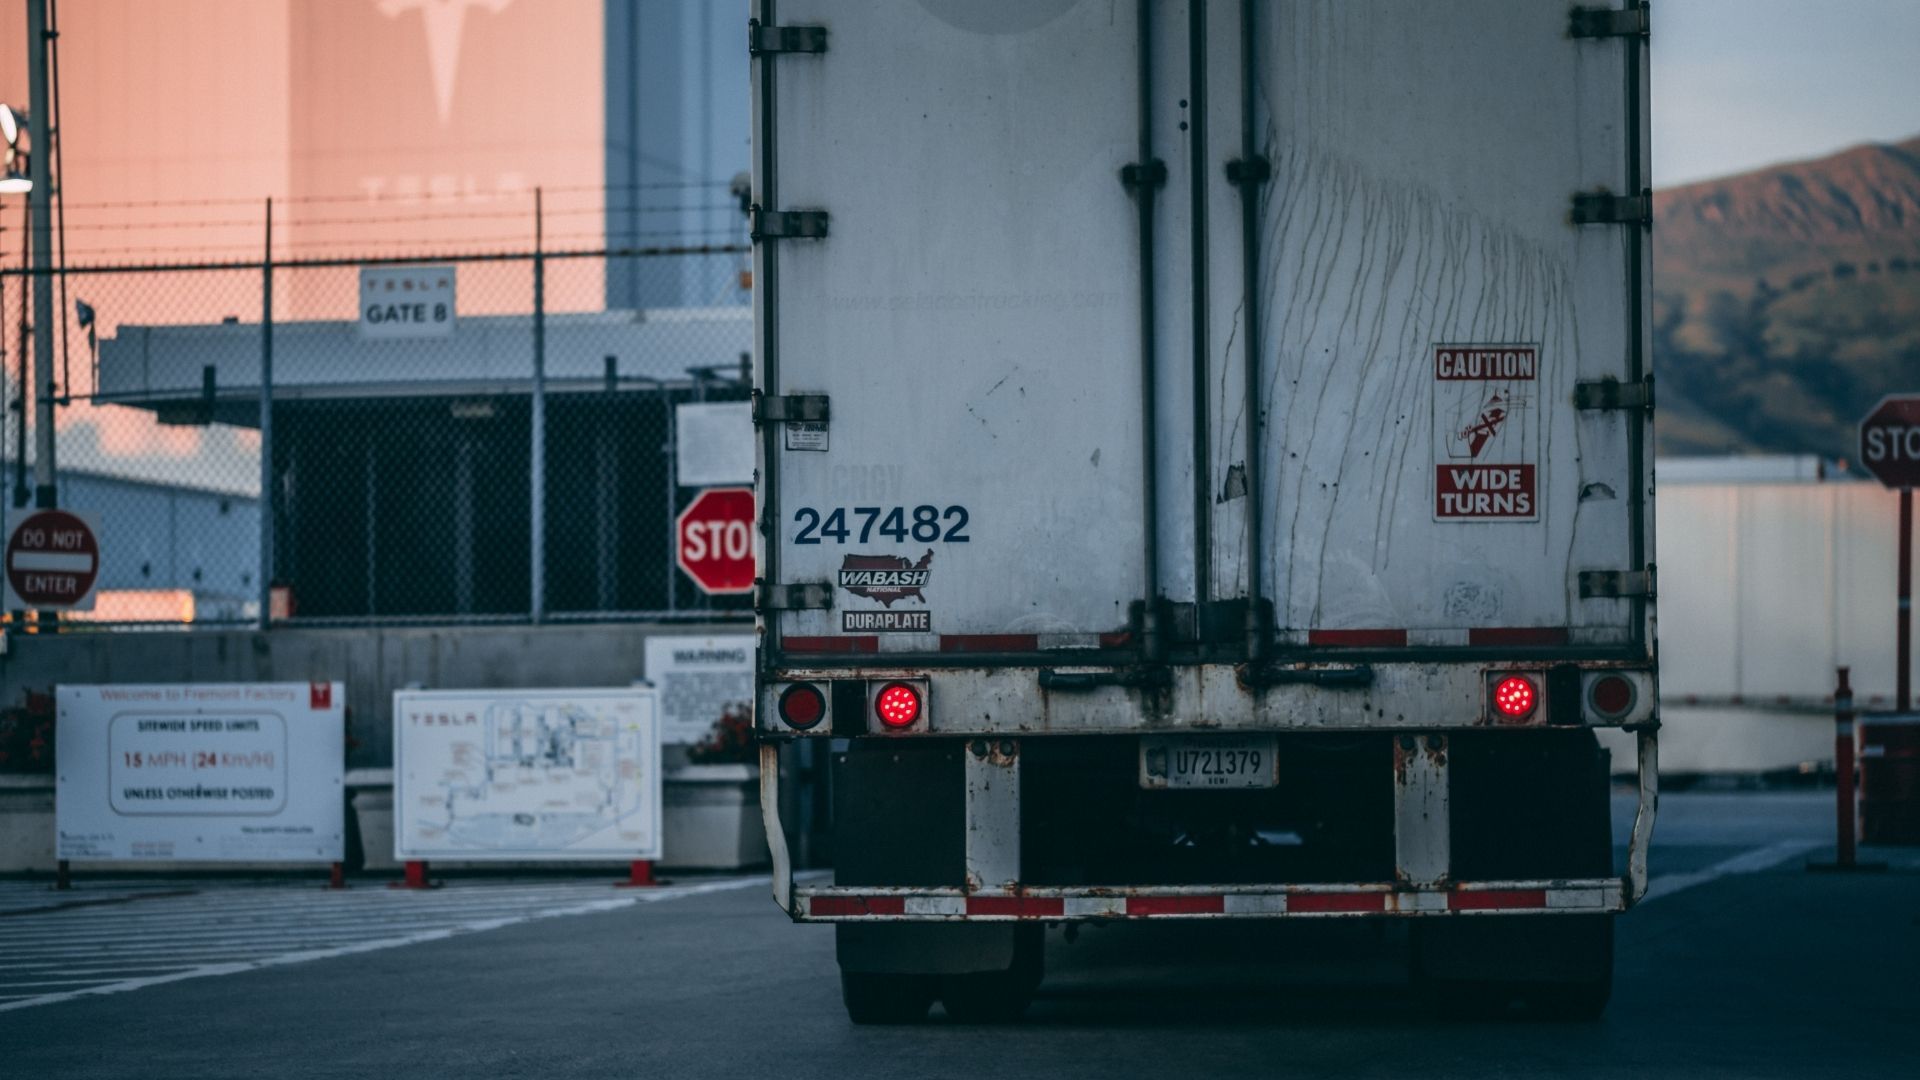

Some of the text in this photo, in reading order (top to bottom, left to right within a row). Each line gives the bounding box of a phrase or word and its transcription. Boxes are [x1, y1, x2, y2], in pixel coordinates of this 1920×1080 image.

[366, 302, 447, 324] GATE 8
[1438, 352, 1533, 378] CAUTION
[1450, 469, 1521, 491] WIDE
[1441, 492, 1531, 514] TURNS
[793, 505, 970, 544] 247482
[22, 529, 83, 548] DO NOT
[685, 520, 755, 561] STO
[25, 575, 77, 594] ENTER
[841, 571, 929, 585] WABASH
[846, 613, 928, 629] DURAPLATE
[673, 648, 746, 663] WARNING
[101, 688, 161, 700] Welcome
[138, 719, 260, 732] SITEWIDE SPEED LIMITS
[410, 712, 477, 726] TESLA
[125, 751, 142, 768] 15
[149, 752, 186, 768] MPH
[193, 751, 216, 770] (24
[1177, 751, 1261, 775] U721379
[124, 786, 274, 799] UNLESS OTHERWISE POSTED
